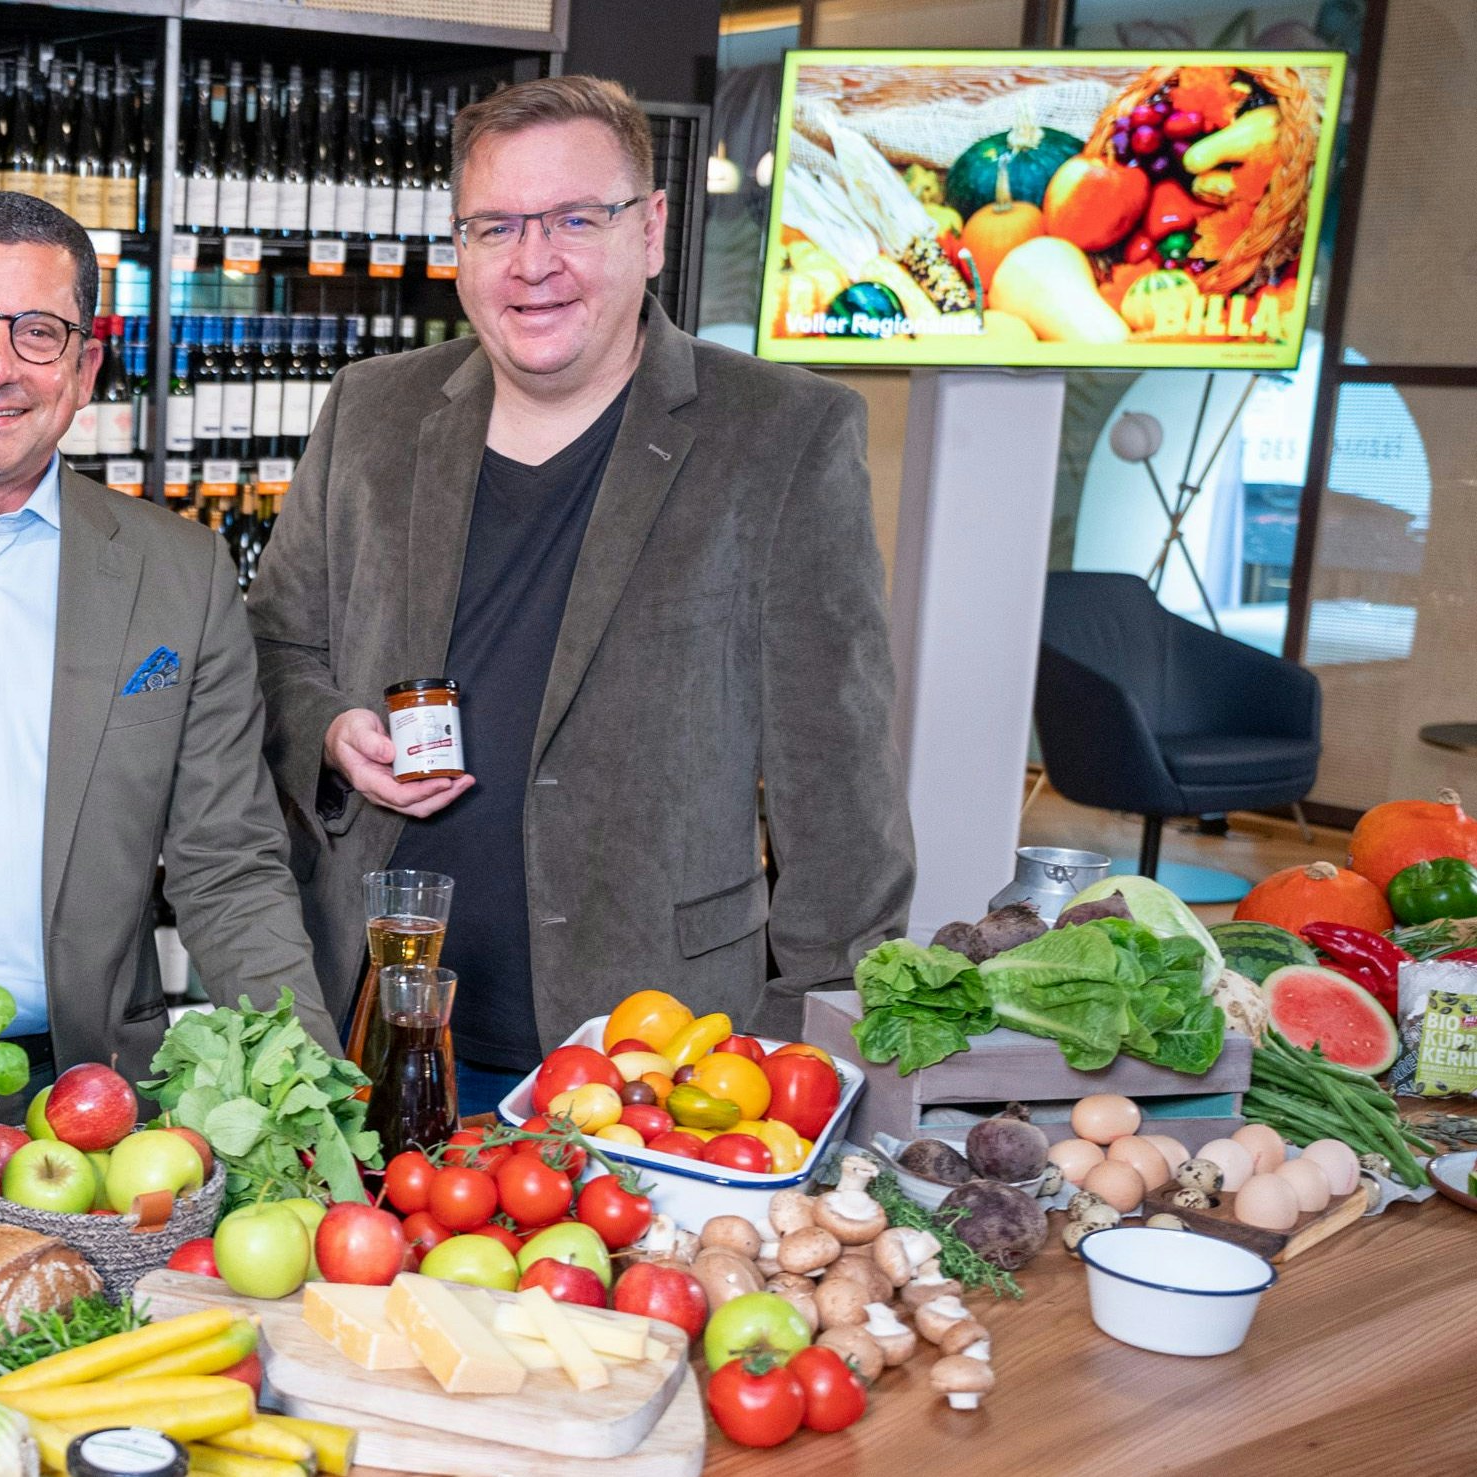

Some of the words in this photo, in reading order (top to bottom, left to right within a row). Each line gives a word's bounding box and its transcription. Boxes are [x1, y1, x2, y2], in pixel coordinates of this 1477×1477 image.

[785, 312, 848, 334] Voller
[1153, 294, 1281, 337] BILLA
[1427, 1011, 1460, 1032] BIO
[1424, 1030, 1477, 1050] KÜRB
